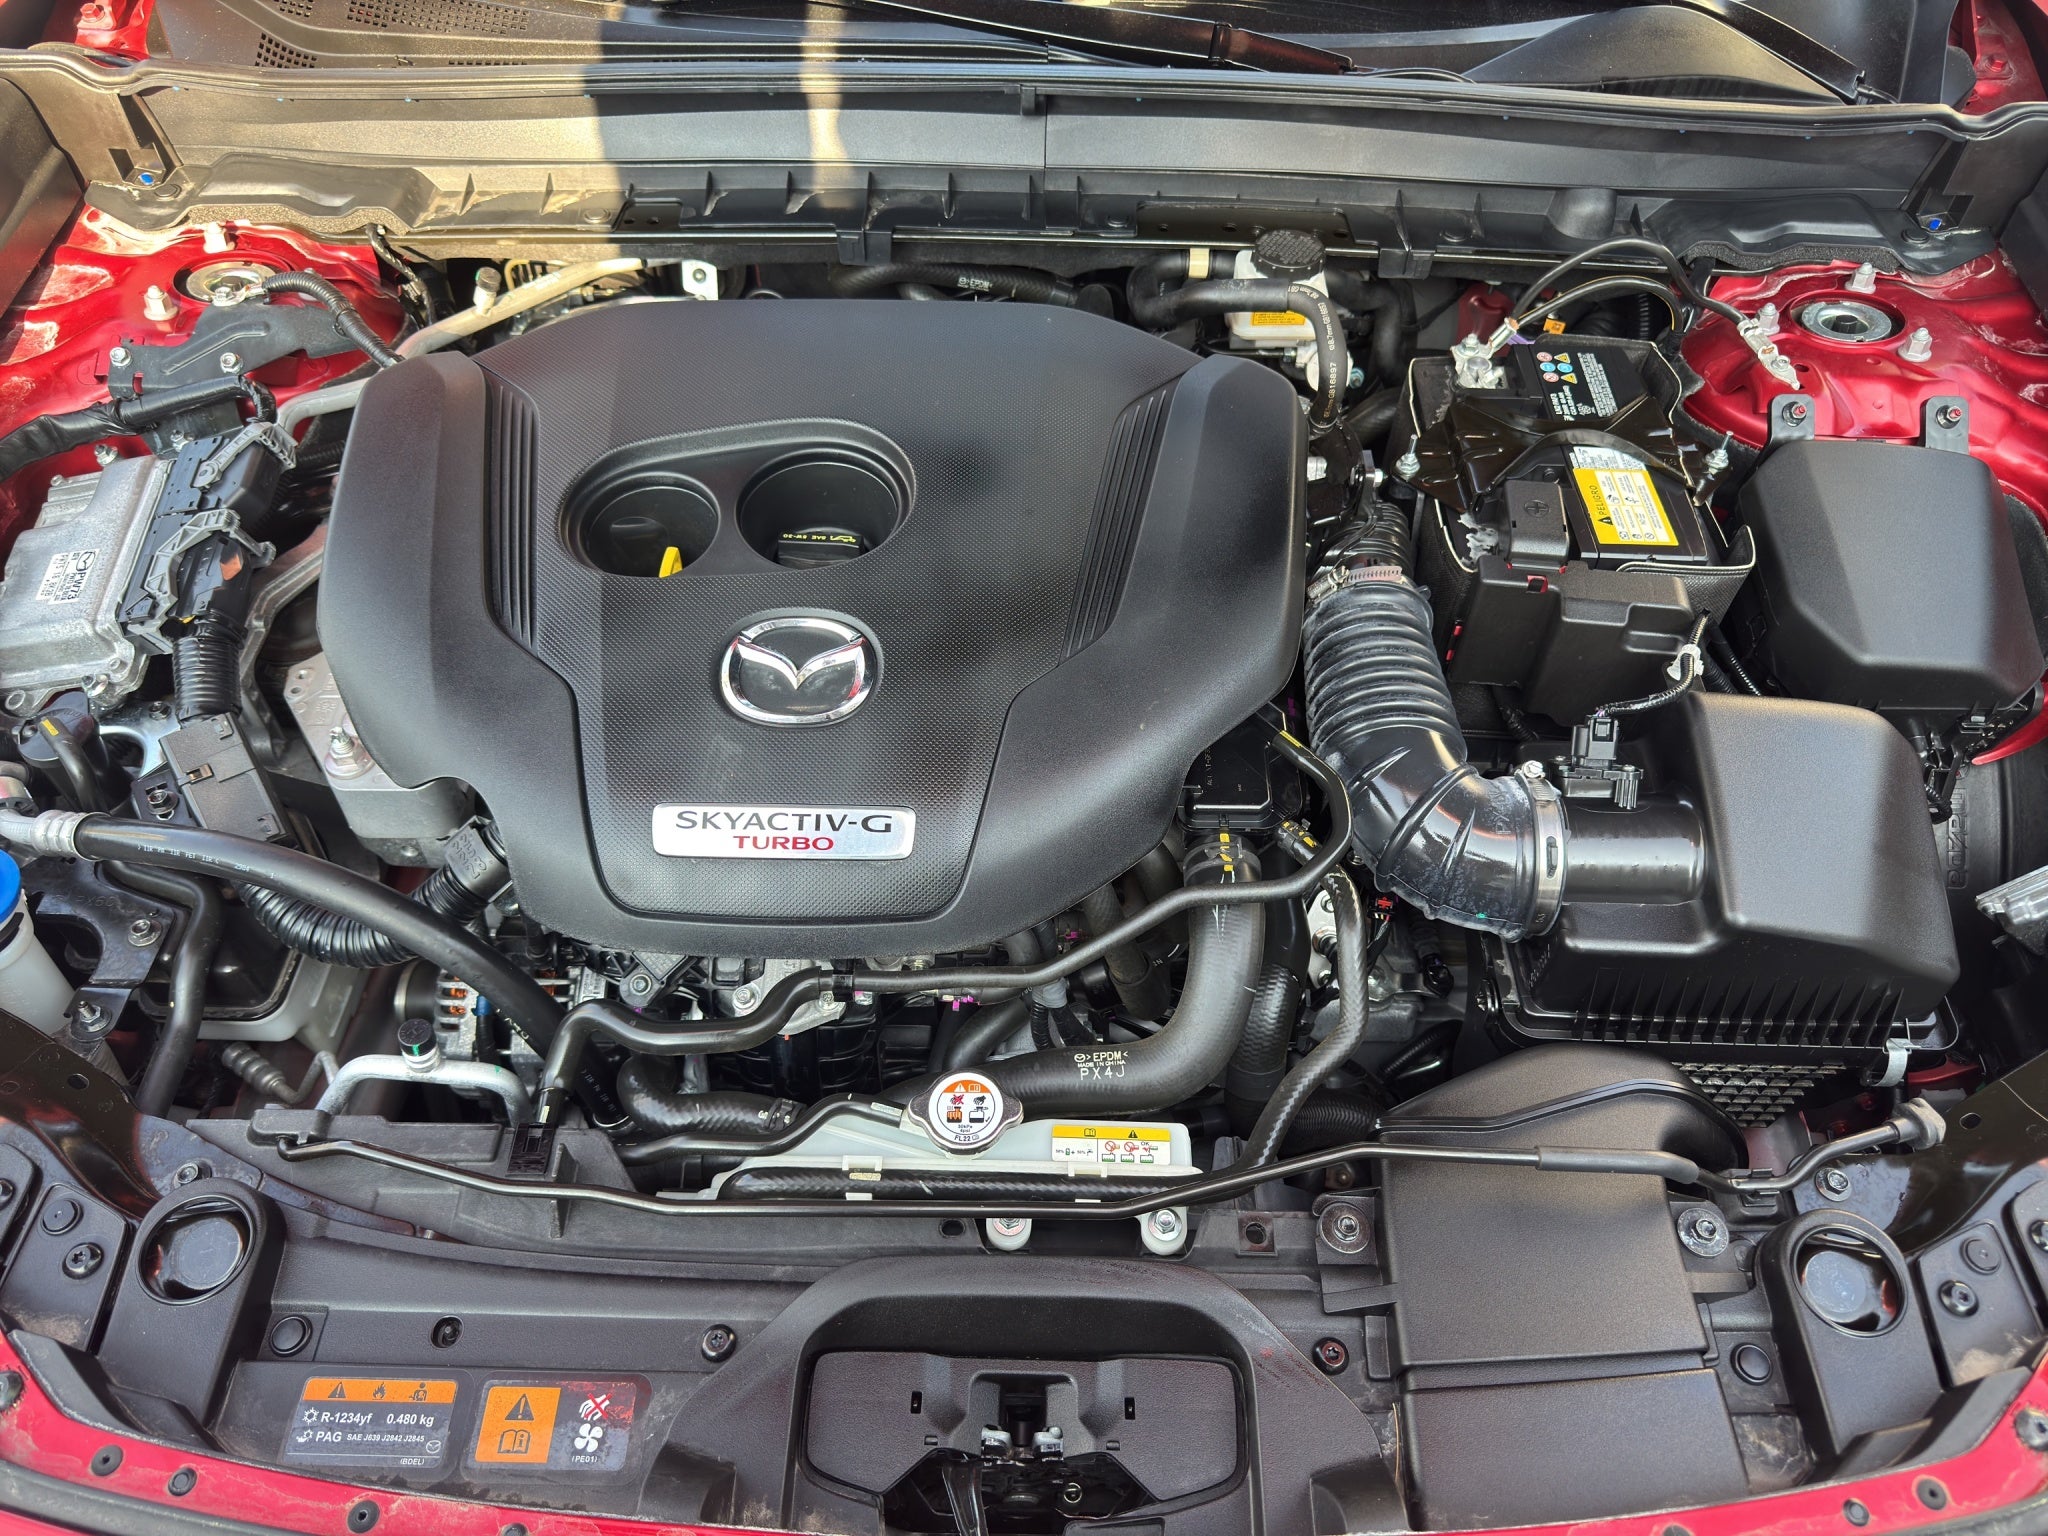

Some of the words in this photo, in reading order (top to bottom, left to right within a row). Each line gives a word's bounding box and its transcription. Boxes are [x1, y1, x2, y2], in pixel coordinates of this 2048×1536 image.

[1589, 485, 1607, 516] PELIGRO
[67, 571, 87, 600] PW73
[675, 810, 893, 833] SKYACTIV-G
[733, 835, 835, 851] TURBO
[1080, 1065, 1125, 1080] PX4J
[320, 1411, 374, 1426] R-1234yf
[386, 1413, 417, 1425] 0.480
[419, 1413, 435, 1428] kg
[315, 1431, 342, 1443] PAG
[363, 1434, 381, 1442] J639
[381, 1434, 403, 1442] J2842
[400, 1458, 425, 1466] (BDEL)
[571, 1455, 598, 1463] (PE01)
